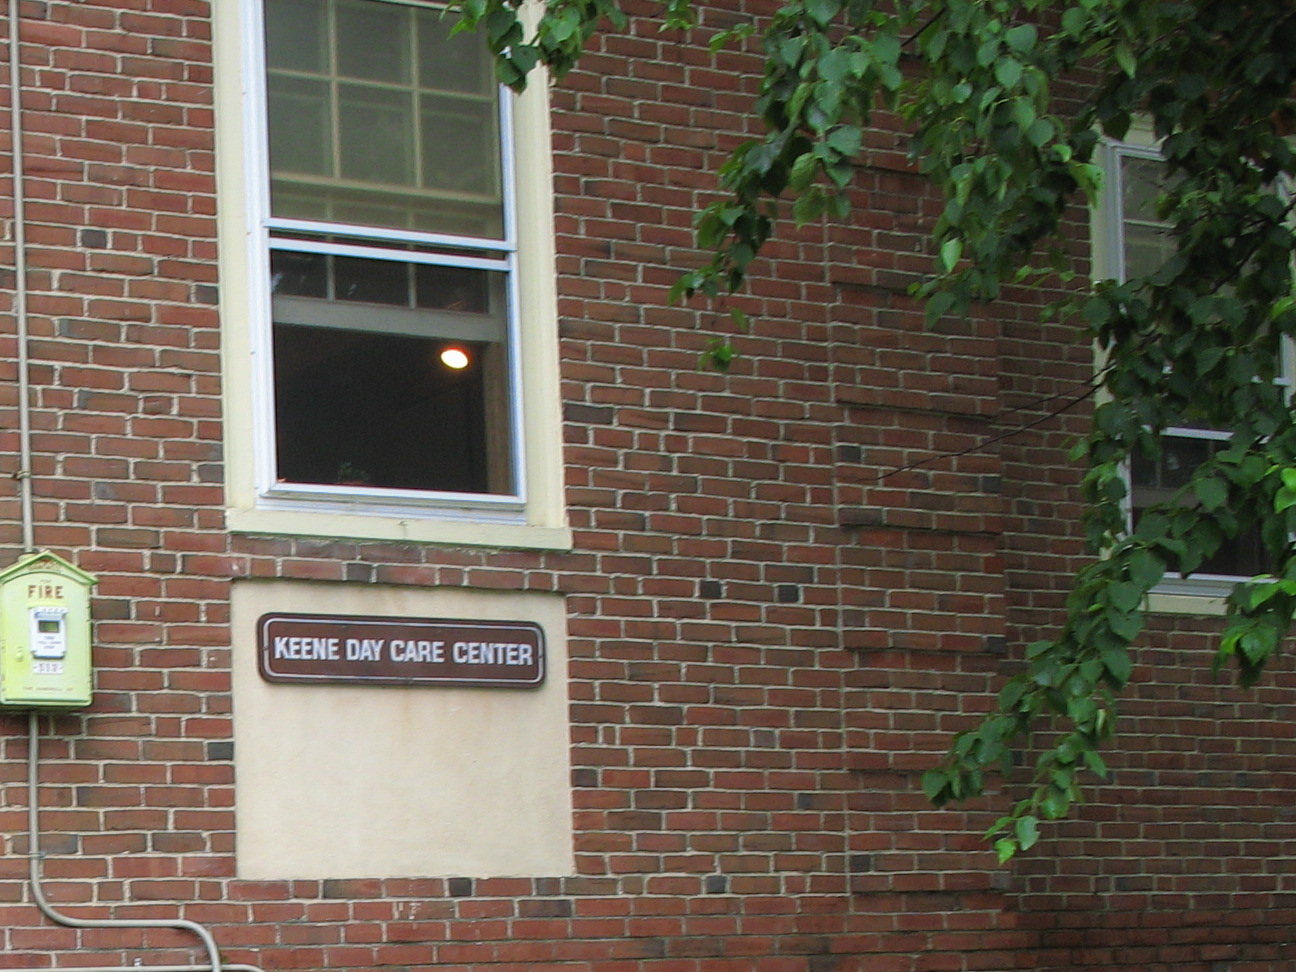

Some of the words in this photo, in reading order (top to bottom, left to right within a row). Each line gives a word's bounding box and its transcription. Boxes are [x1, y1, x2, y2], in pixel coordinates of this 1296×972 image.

[27, 585, 64, 599] FIRE
[274, 636, 340, 660] KEENE
[346, 638, 384, 661] DAY
[389, 640, 445, 662] CARE
[452, 642, 533, 665] CENTER
